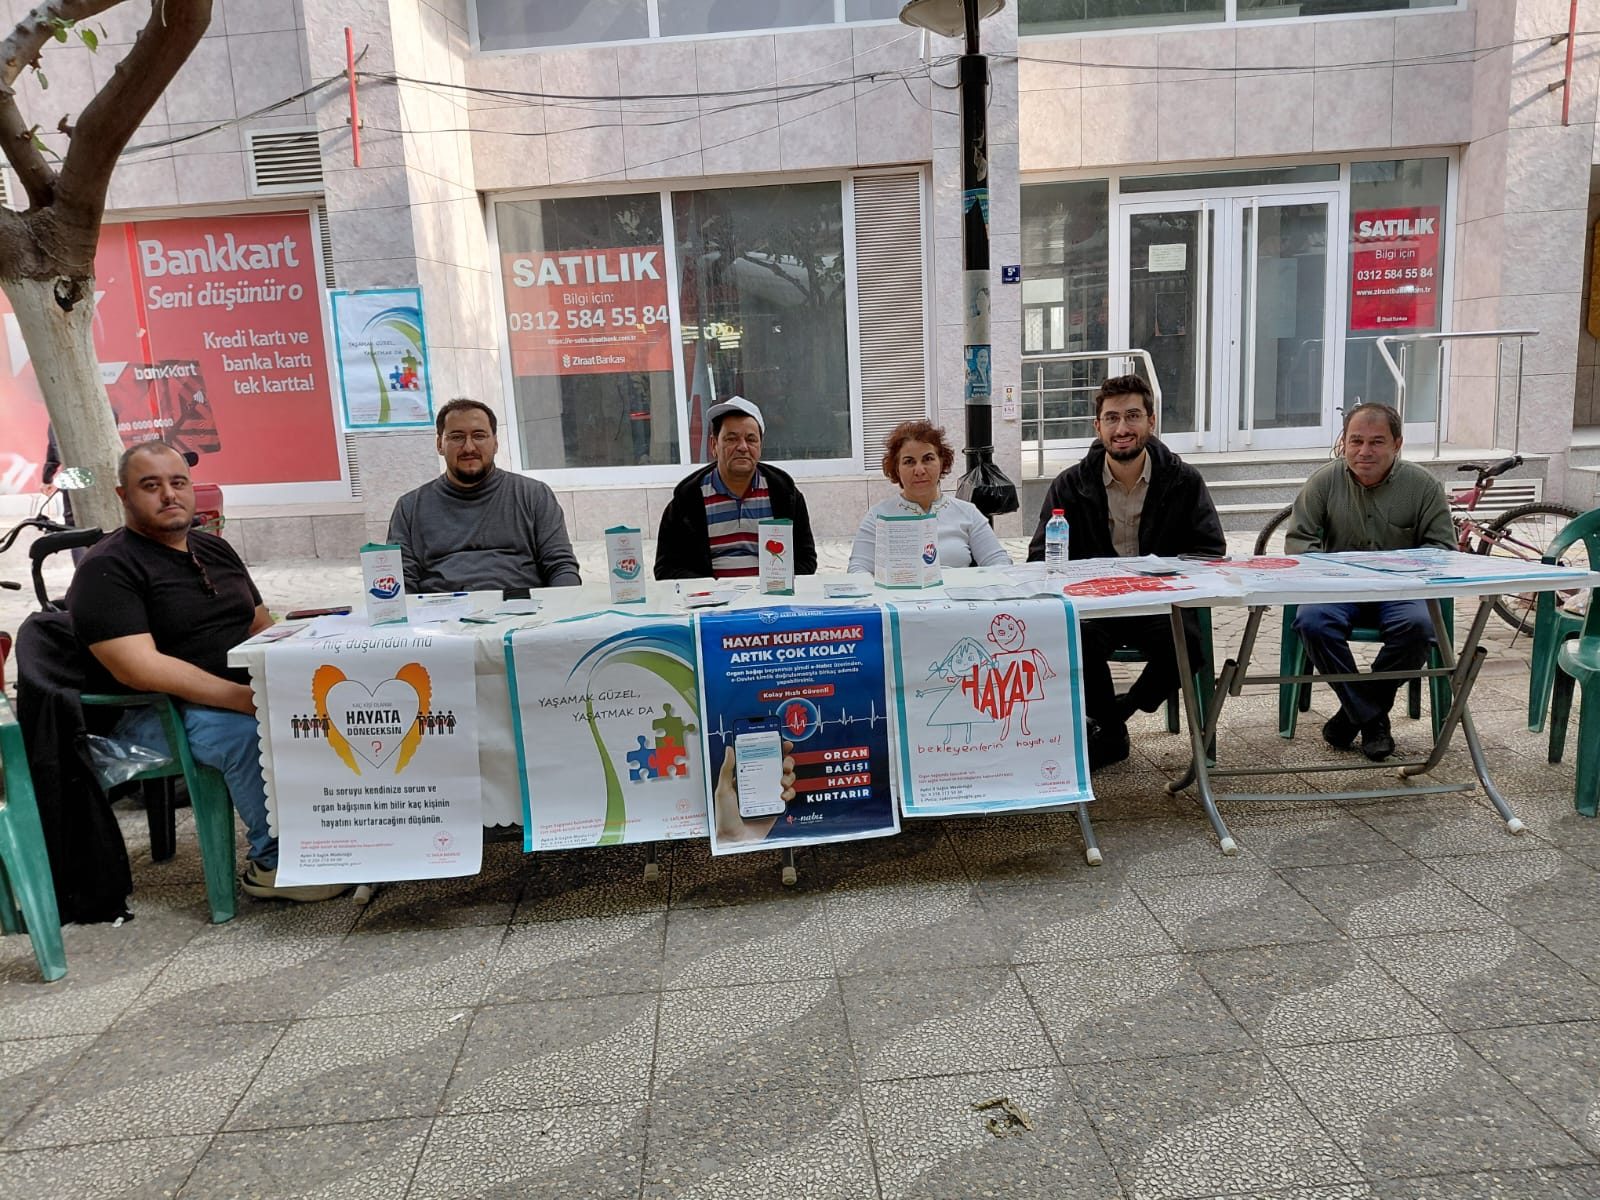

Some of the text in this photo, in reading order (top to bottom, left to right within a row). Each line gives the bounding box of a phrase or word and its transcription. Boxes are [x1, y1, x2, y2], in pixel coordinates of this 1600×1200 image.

[1359, 217, 1435, 238] SATILIK
[138, 233, 299, 278] Bankkart
[1375, 249, 1416, 260] Bilgi için
[511, 251, 661, 288] SATILIK
[1357, 267, 1434, 281] 0312 584 55 84
[147, 279, 304, 311] Seni düşünür o
[563, 292, 615, 307] Bilgi için:
[509, 305, 669, 331] 0312 584 55 84
[203, 330, 310, 350] Kredi kartı ve
[222, 351, 312, 373] banka kartı
[572, 354, 625, 366] Ziraat Bankası
[234, 372, 315, 395] tek kartta!
[412, 635, 433, 648] mü
[722, 627, 862, 649] HAYAT KURTARMAK
[730, 643, 856, 664] ARTIK ÇOK KOLAY
[802, 687, 830, 695] Güvenli
[961, 660, 1036, 720] HAYAT
[538, 689, 641, 708] YAŞAMAK GÜZEL,
[346, 710, 401, 725] HAYATA
[572, 706, 655, 722] YAŞATMAK DA
[347, 725, 402, 736] DÖNECEKSİN
[823, 749, 868, 761] ORGAN
[917, 742, 1004, 756] bekleyenlerin
[825, 761, 869, 774] BAĞIŞI
[827, 775, 869, 787] HAYAT
[323, 787, 334, 796] Bu
[336, 787, 363, 797] soruyu
[364, 785, 402, 795] kendinize
[404, 785, 426, 794] sorun
[806, 789, 870, 803] KURTARIR
[312, 798, 450, 813] organ bağışının kim bilir kaç kişinin
[321, 815, 443, 829] hayatını kurtaracağını düşünün.
